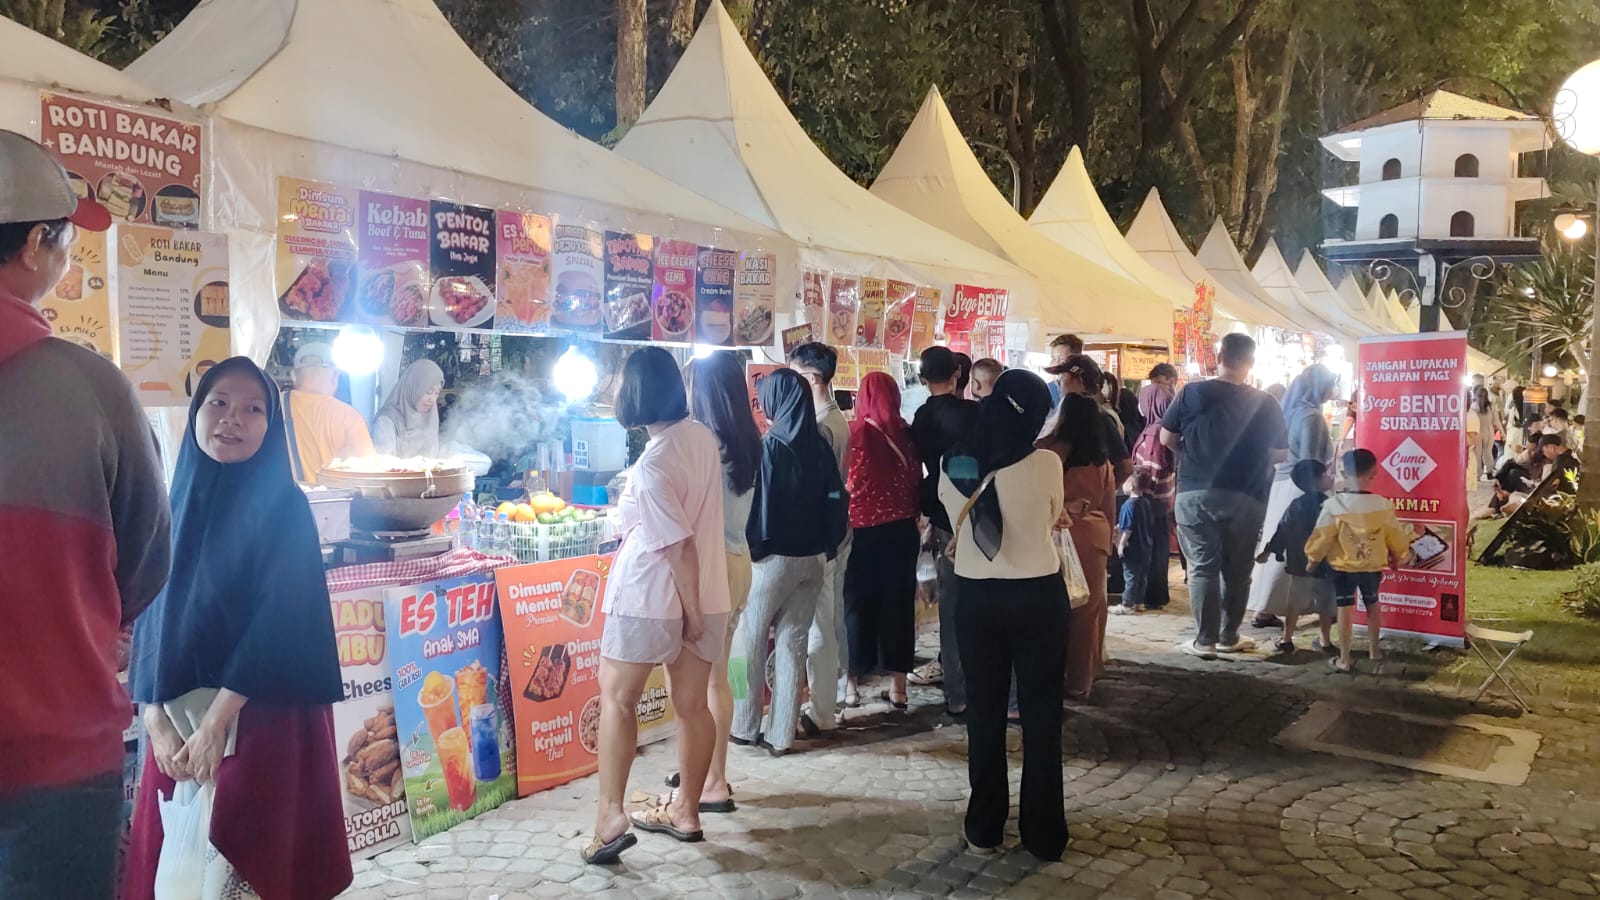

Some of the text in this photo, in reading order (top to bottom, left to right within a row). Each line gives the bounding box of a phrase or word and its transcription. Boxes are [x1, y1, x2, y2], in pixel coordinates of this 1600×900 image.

[49, 106, 197, 154] ROTI BAKAR
[58, 133, 182, 176] BANDUNG
[125, 166, 140, 174] dan
[299, 187, 346, 205] Dimsum
[290, 200, 352, 222] Mentai
[367, 202, 428, 227] Kebab
[368, 223, 427, 240] Beef & Tuna
[434, 211, 490, 235] PENTOL
[503, 223, 518, 239] ES
[150, 238, 202, 252] ROTI BAKAR
[436, 230, 490, 253] BAKAR
[154, 252, 199, 267] Bandung
[745, 257, 768, 271] NASI
[740, 271, 770, 285] BAKAR
[864, 290, 883, 298] JUMBO
[948, 290, 977, 319] Sego
[74, 326, 96, 337] MILO
[1366, 358, 1457, 371] JANGAN LUPAKAN
[1372, 371, 1449, 382] SARAPAN PAGI
[1363, 394, 1461, 413] Sego BENTO
[1380, 417, 1461, 431] SURABAYA
[1389, 452, 1426, 467] Cuma
[1395, 467, 1420, 480] 10K
[1388, 498, 1440, 512] KMAT
[508, 581, 563, 600] Dimsum
[400, 582, 496, 638] ES TEH
[515, 594, 562, 616] Mentai
[332, 600, 385, 630] ADU
[423, 627, 480, 659] Anak SMA
[567, 639, 601, 656] Dims
[575, 653, 600, 670] Bak
[343, 677, 392, 699] Chees
[531, 710, 573, 736] Pentol
[534, 727, 572, 753] Kriwil
[348, 821, 400, 852] ARELLA
